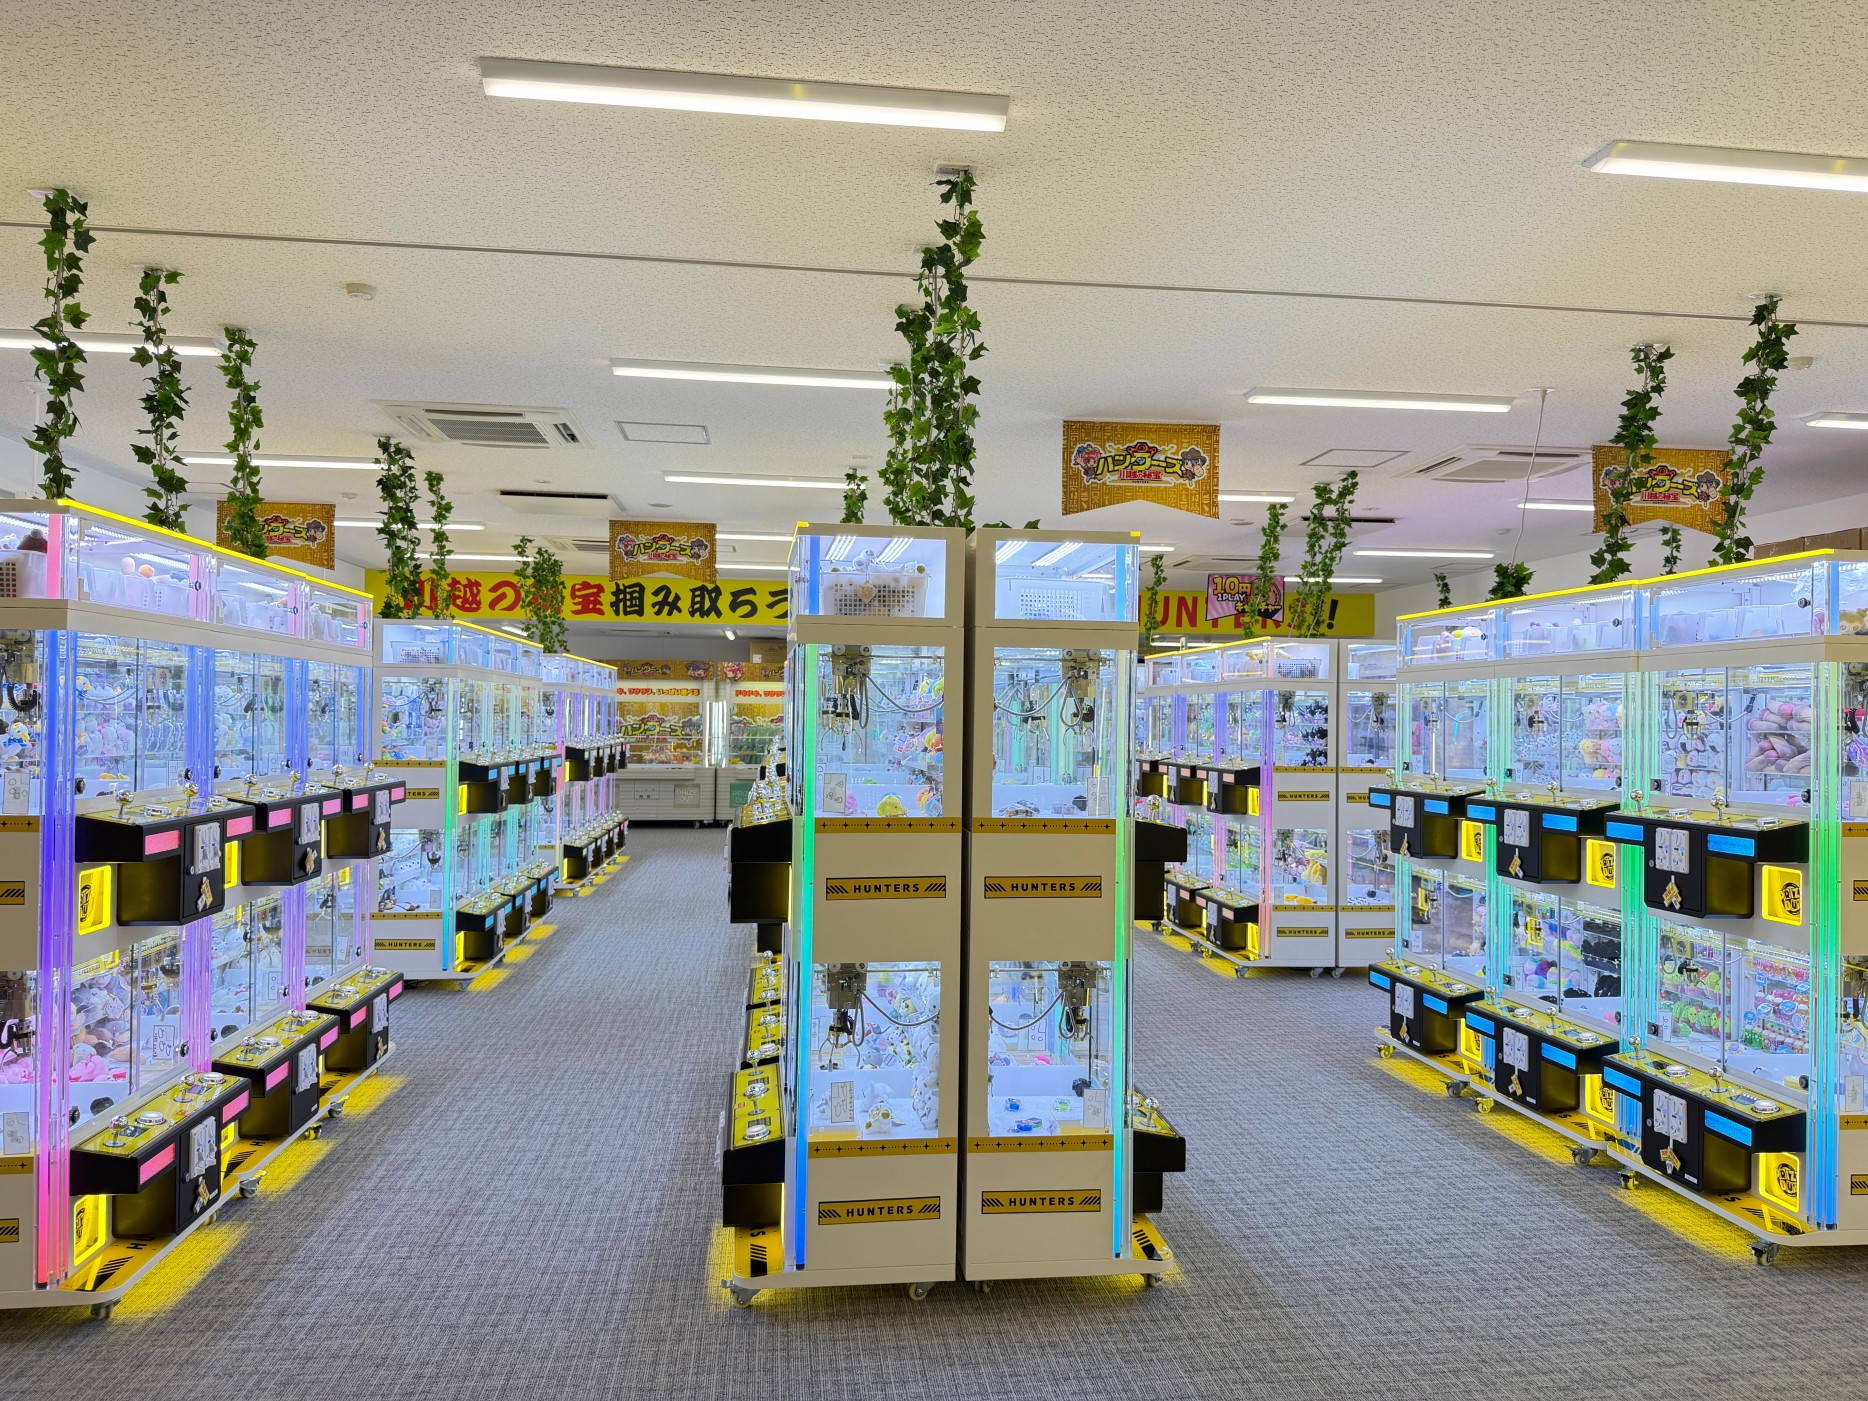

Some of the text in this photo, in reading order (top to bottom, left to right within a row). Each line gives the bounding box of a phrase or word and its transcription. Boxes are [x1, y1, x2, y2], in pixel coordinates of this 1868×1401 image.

[1097, 452, 1183, 478] ハンターズ
[1213, 576, 1251, 596] 10円
[1235, 601, 1282, 612] キャチャー
[853, 883, 920, 894] HUNTERS
[1010, 882, 1076, 892] HUNTERS
[1009, 1196, 1075, 1207] HUNTERS
[846, 1205, 914, 1217] HUNTERS
